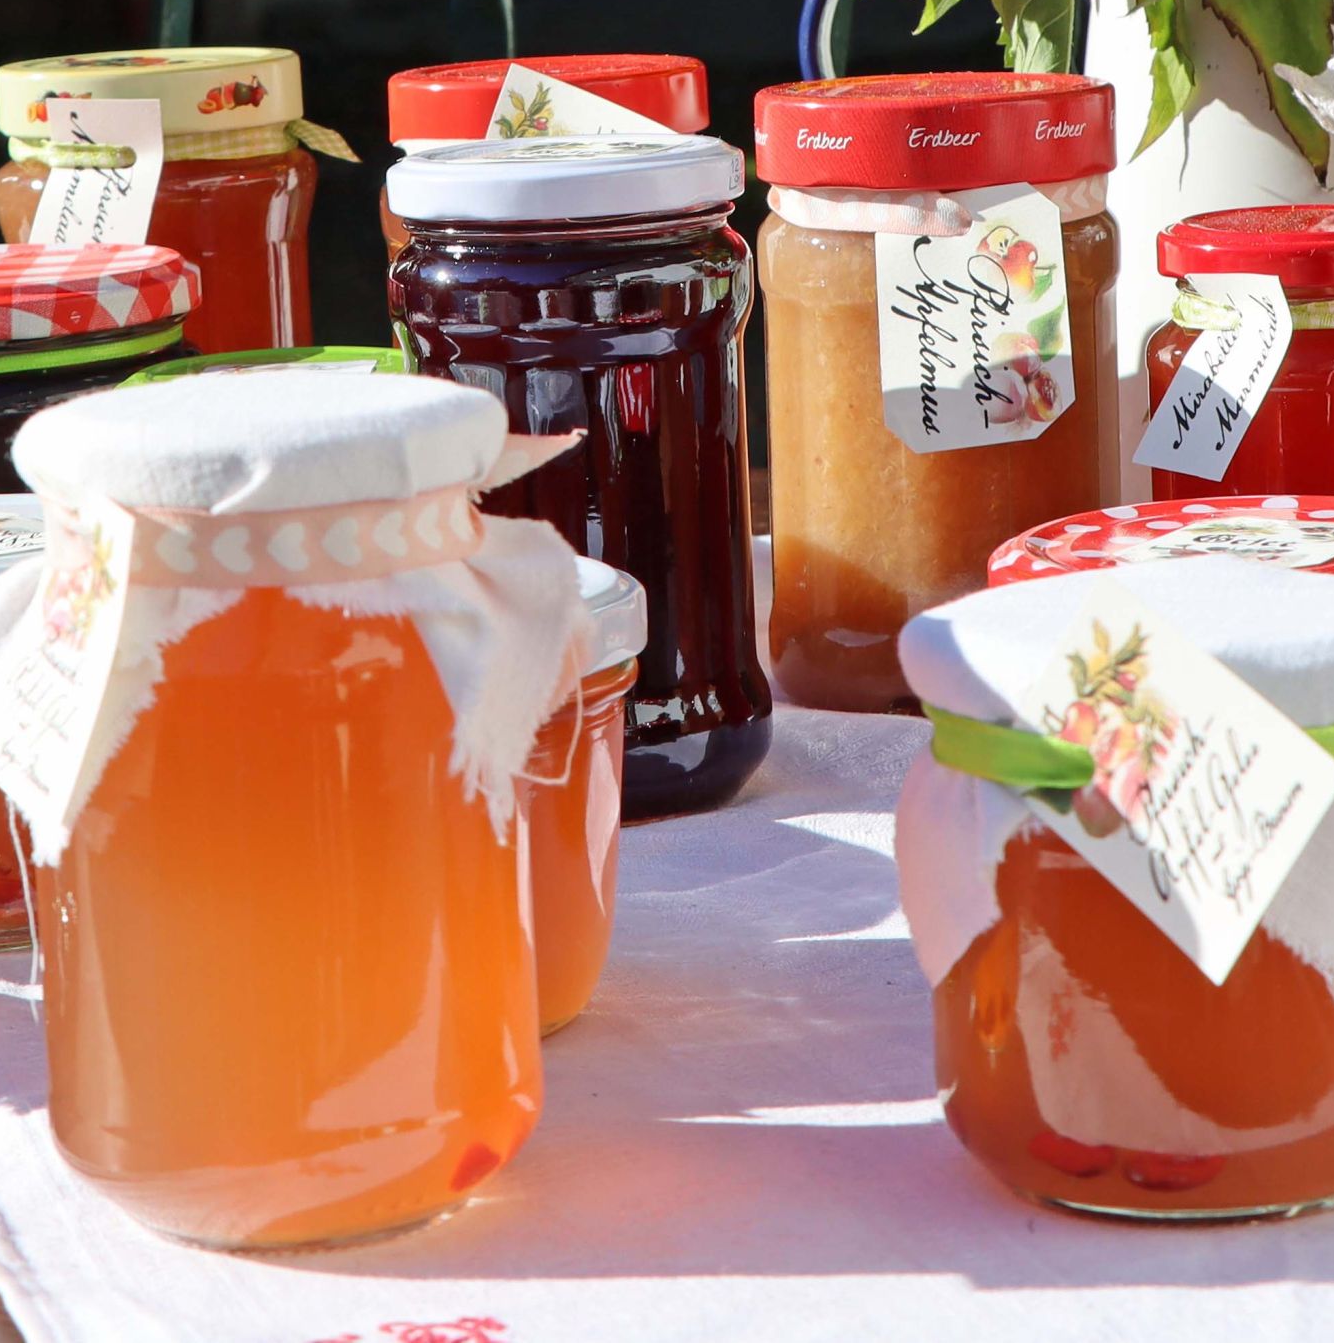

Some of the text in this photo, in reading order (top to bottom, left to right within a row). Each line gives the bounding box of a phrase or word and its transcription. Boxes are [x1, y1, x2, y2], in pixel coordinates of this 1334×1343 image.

[796, 128, 854, 150] Erdbeer
[908, 127, 982, 149] Erdbeer
[1034, 118, 1087, 142] Erdbeer
[890, 235, 959, 436] Apfelmus
[942, 254, 1014, 429] Pfirsich-
[1214, 293, 1278, 451] Marmelade
